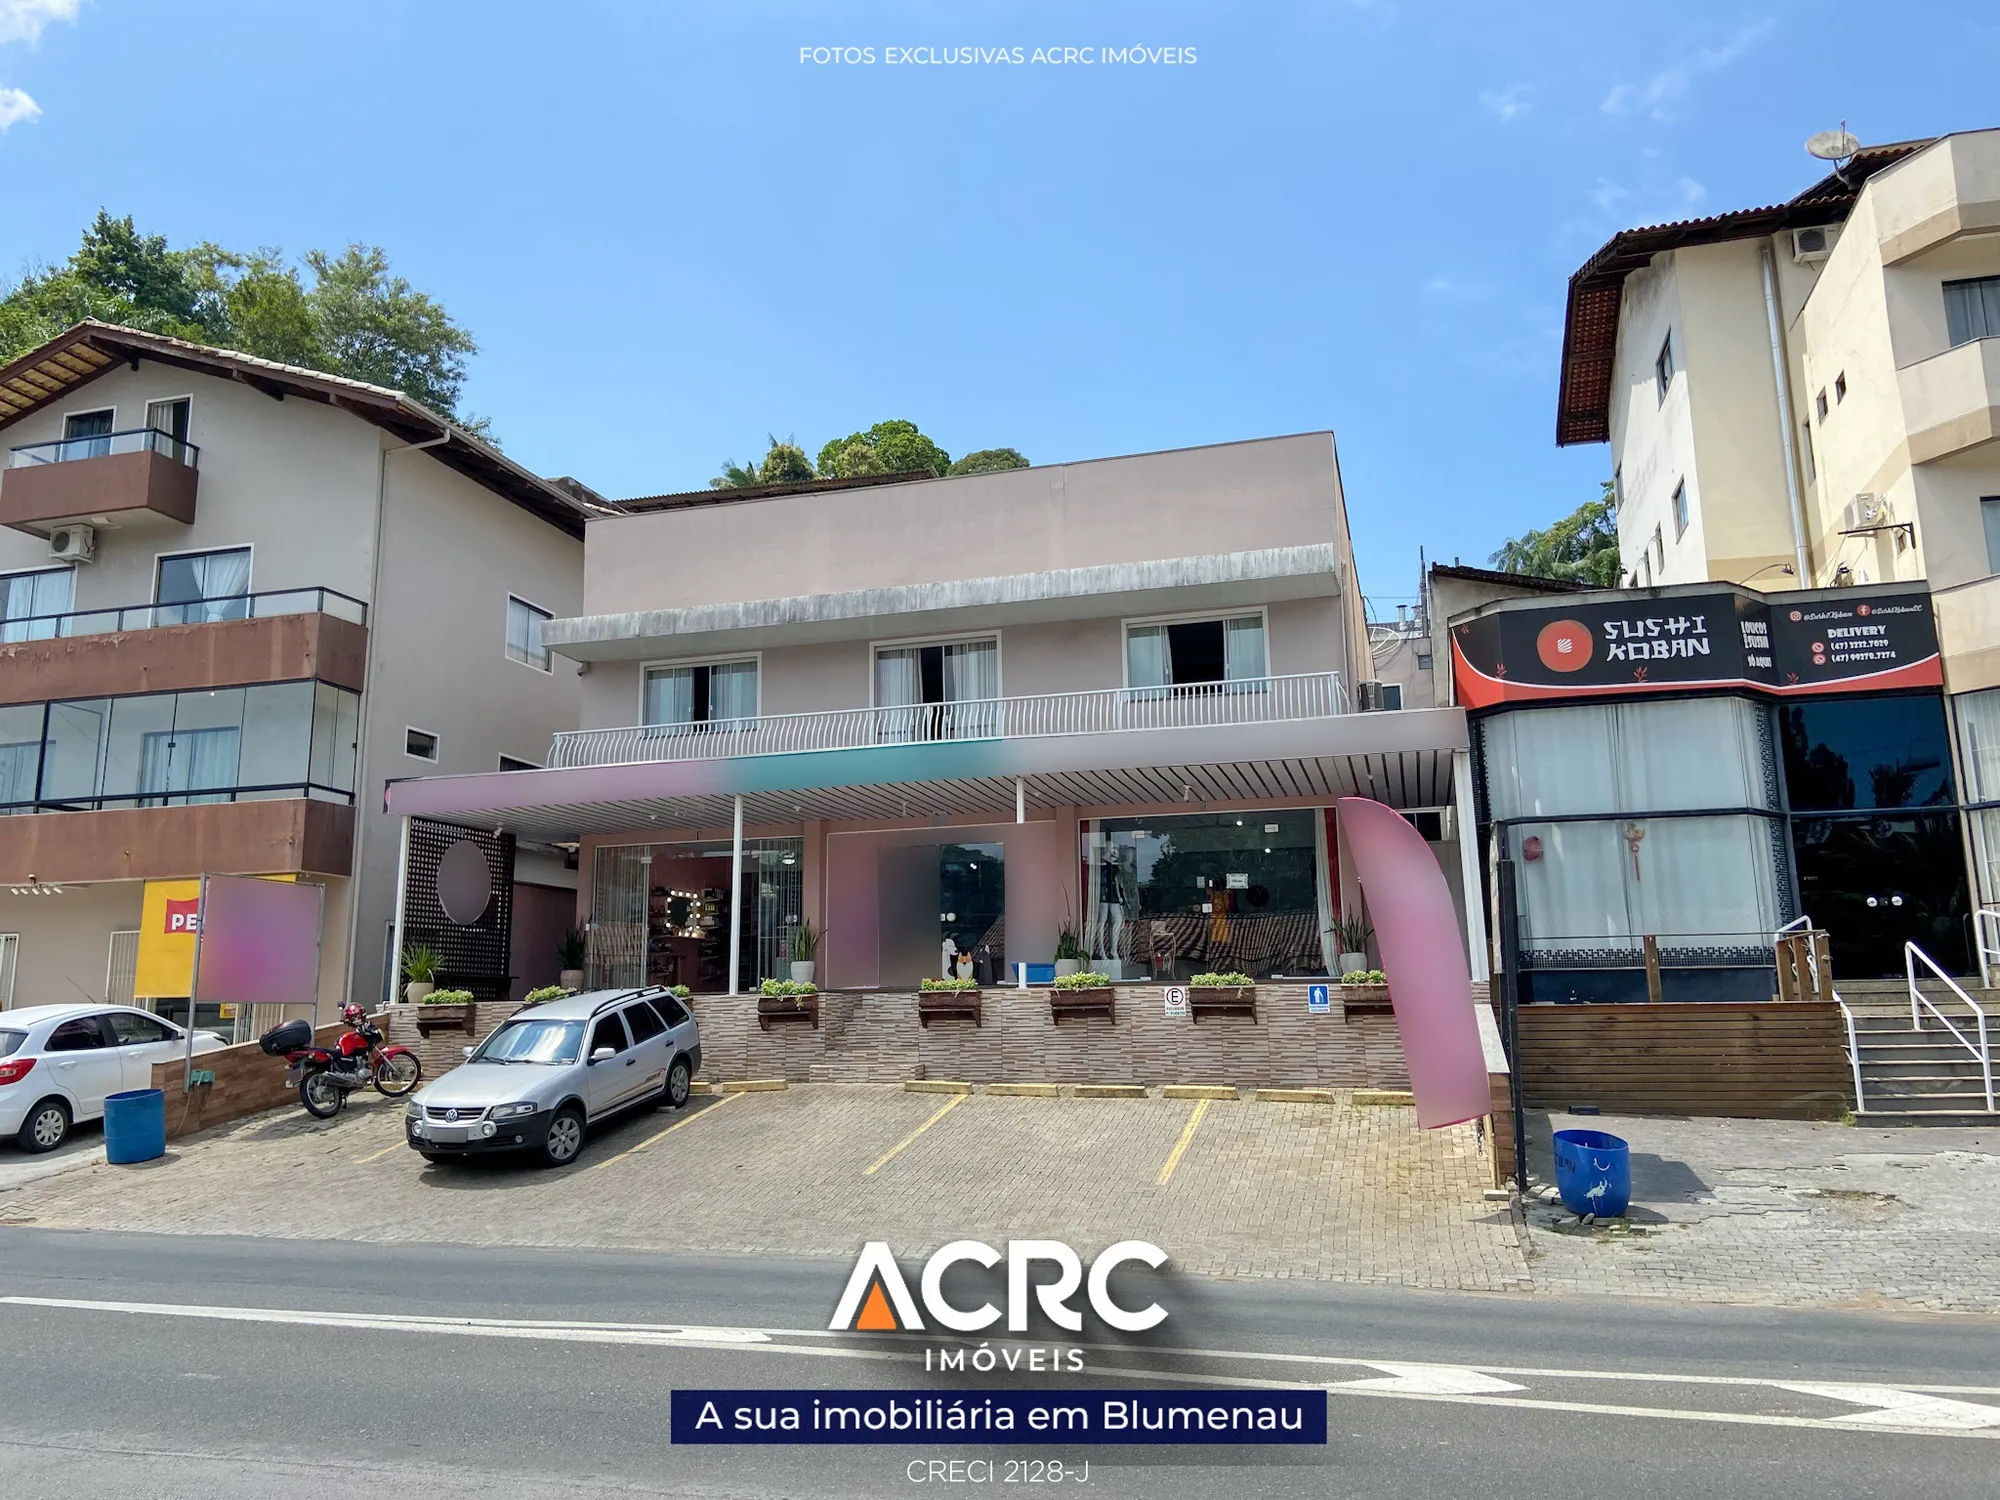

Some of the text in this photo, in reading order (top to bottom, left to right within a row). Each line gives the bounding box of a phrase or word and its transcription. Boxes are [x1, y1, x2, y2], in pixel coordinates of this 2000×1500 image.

[1603, 615, 1707, 640] SUSHI
[1740, 620, 1768, 635] LOUCOS
[1827, 625, 1887, 639] DELIVERY
[1606, 637, 1711, 662] KOBAN
[1830, 642, 1849, 651] (47)
[1831, 653, 1849, 663] (47)
[1171, 990, 1179, 1003] E
